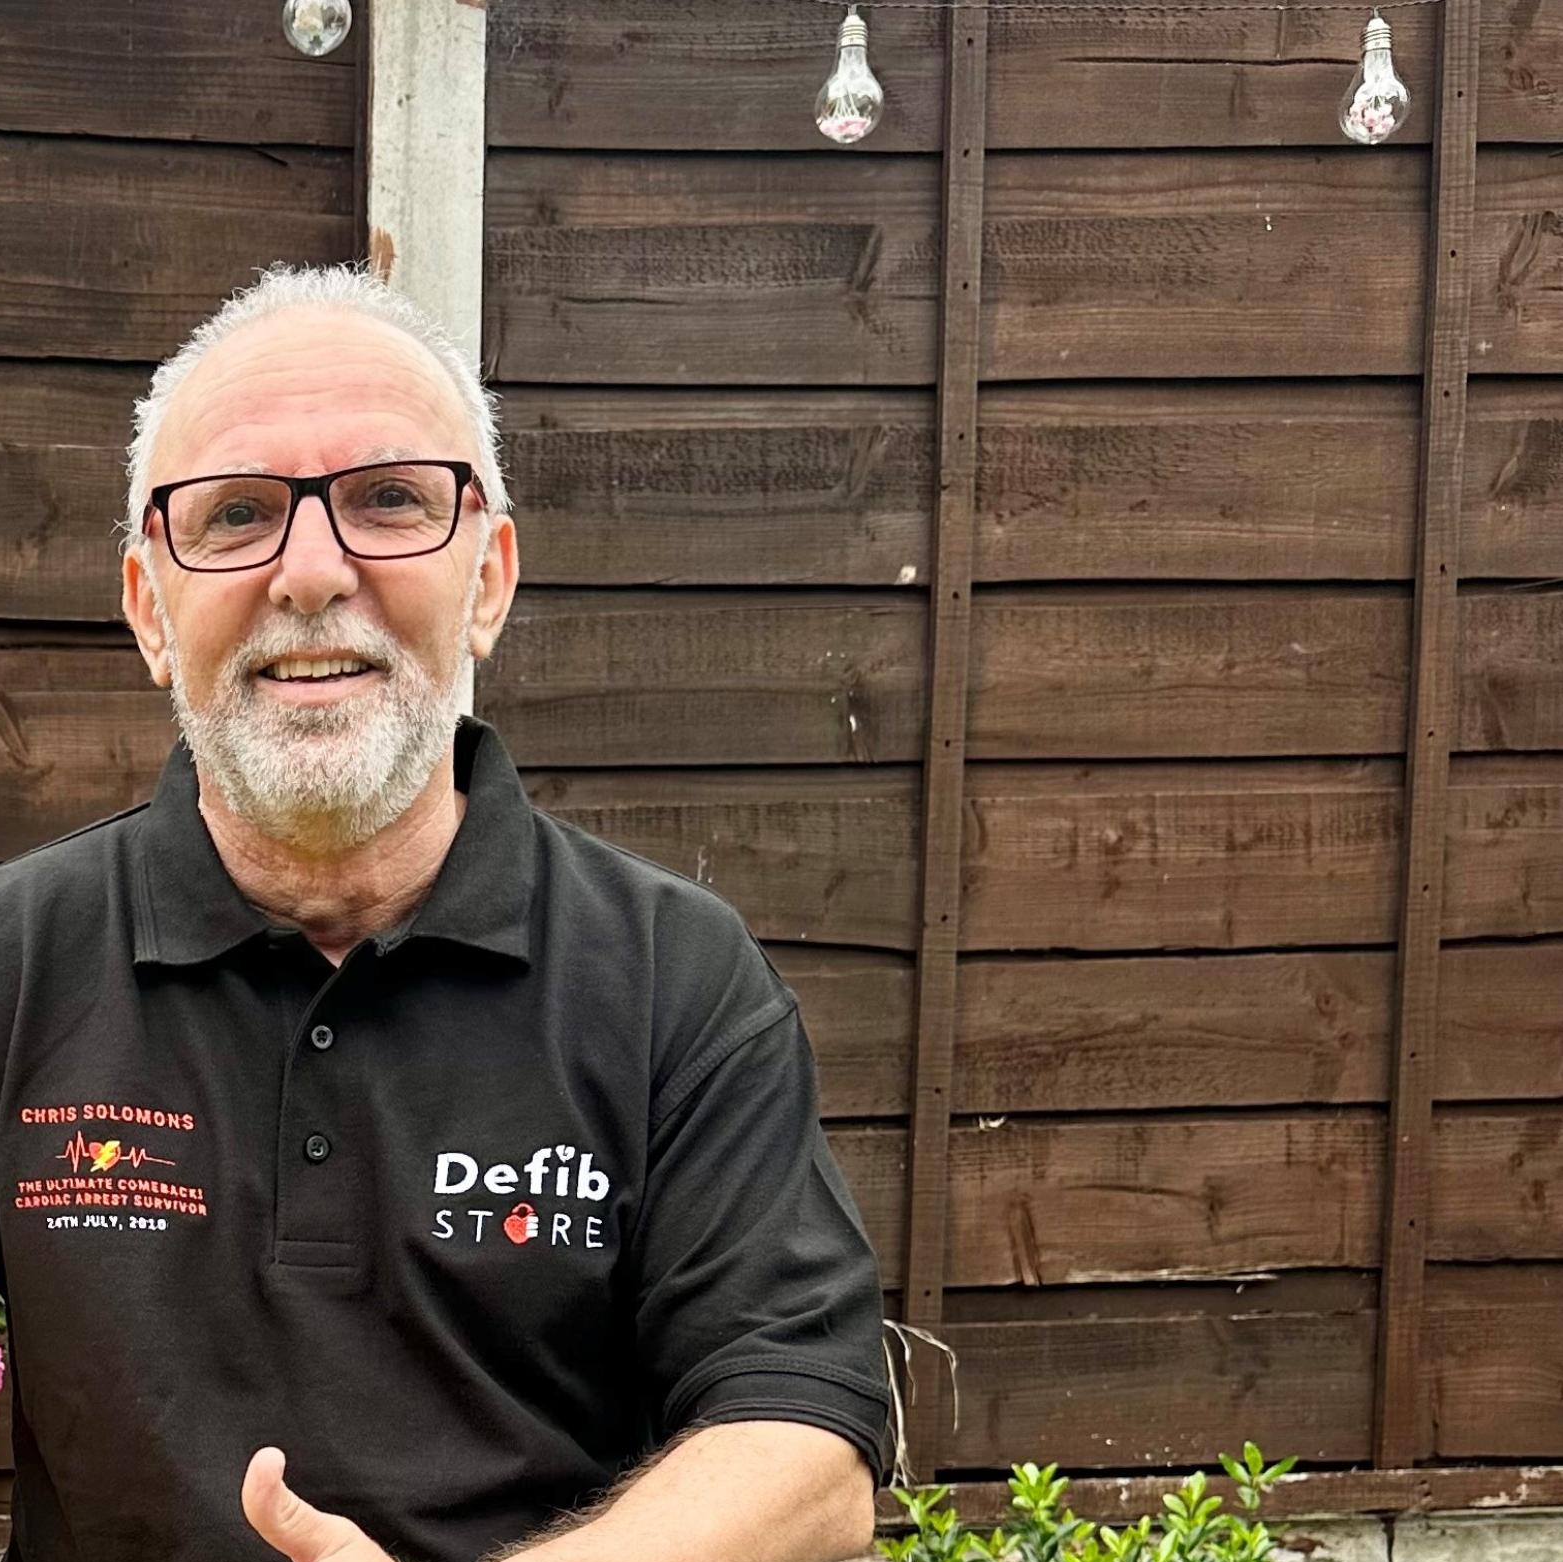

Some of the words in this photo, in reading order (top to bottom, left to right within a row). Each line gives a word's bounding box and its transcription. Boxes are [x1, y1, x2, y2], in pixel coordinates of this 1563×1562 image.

[21, 1106, 77, 1124] CHRIS
[83, 1103, 195, 1130] SOLOMONS
[18, 1179, 42, 1193] THE
[46, 1177, 112, 1191] ULTIMATE
[434, 1145, 610, 1201] Defib
[15, 1194, 71, 1209] CARDIAC
[76, 1192, 128, 1206] ARREST
[133, 1195, 207, 1216] SURVIVOR
[46, 1216, 79, 1230] 24TH
[83, 1215, 123, 1231] JULY,
[129, 1216, 168, 1231] 2010
